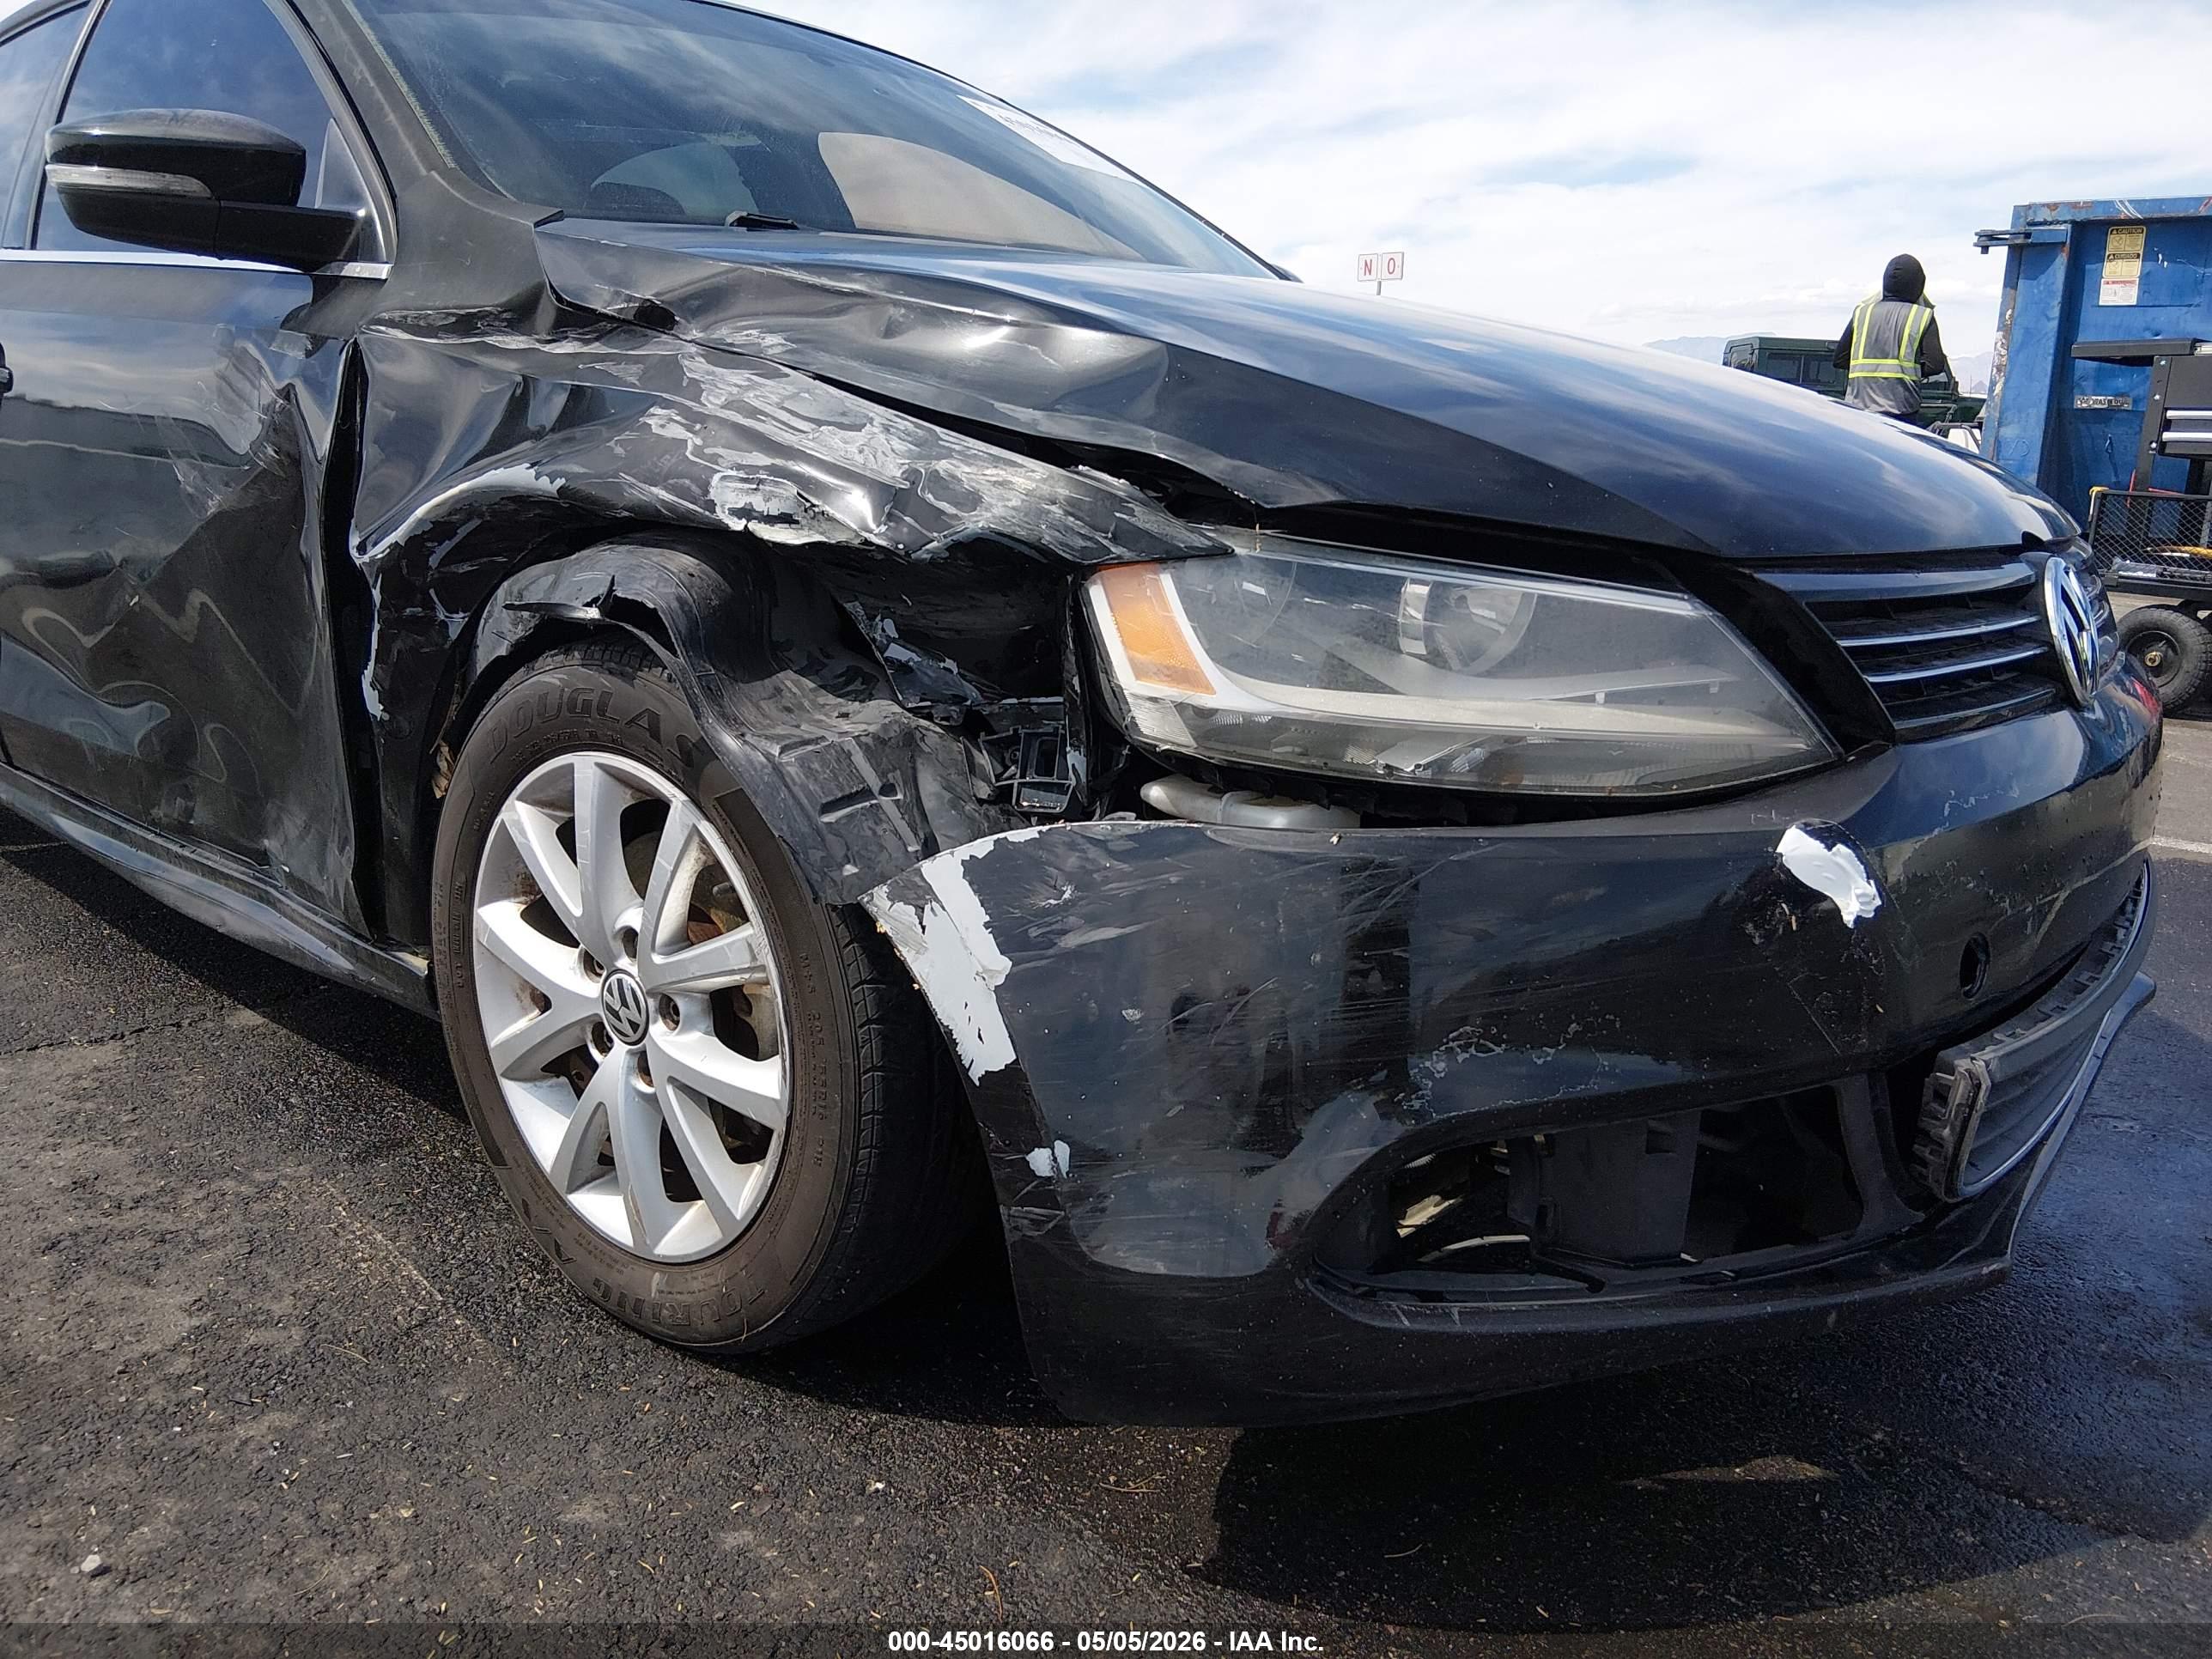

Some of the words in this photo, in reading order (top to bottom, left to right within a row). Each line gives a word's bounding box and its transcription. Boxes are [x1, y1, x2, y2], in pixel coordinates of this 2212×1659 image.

[1364, 258, 1373, 276] N
[1387, 257, 1396, 276] O
[488, 686, 695, 769] DOUGLAS
[592, 1270, 766, 1327] TOURING
